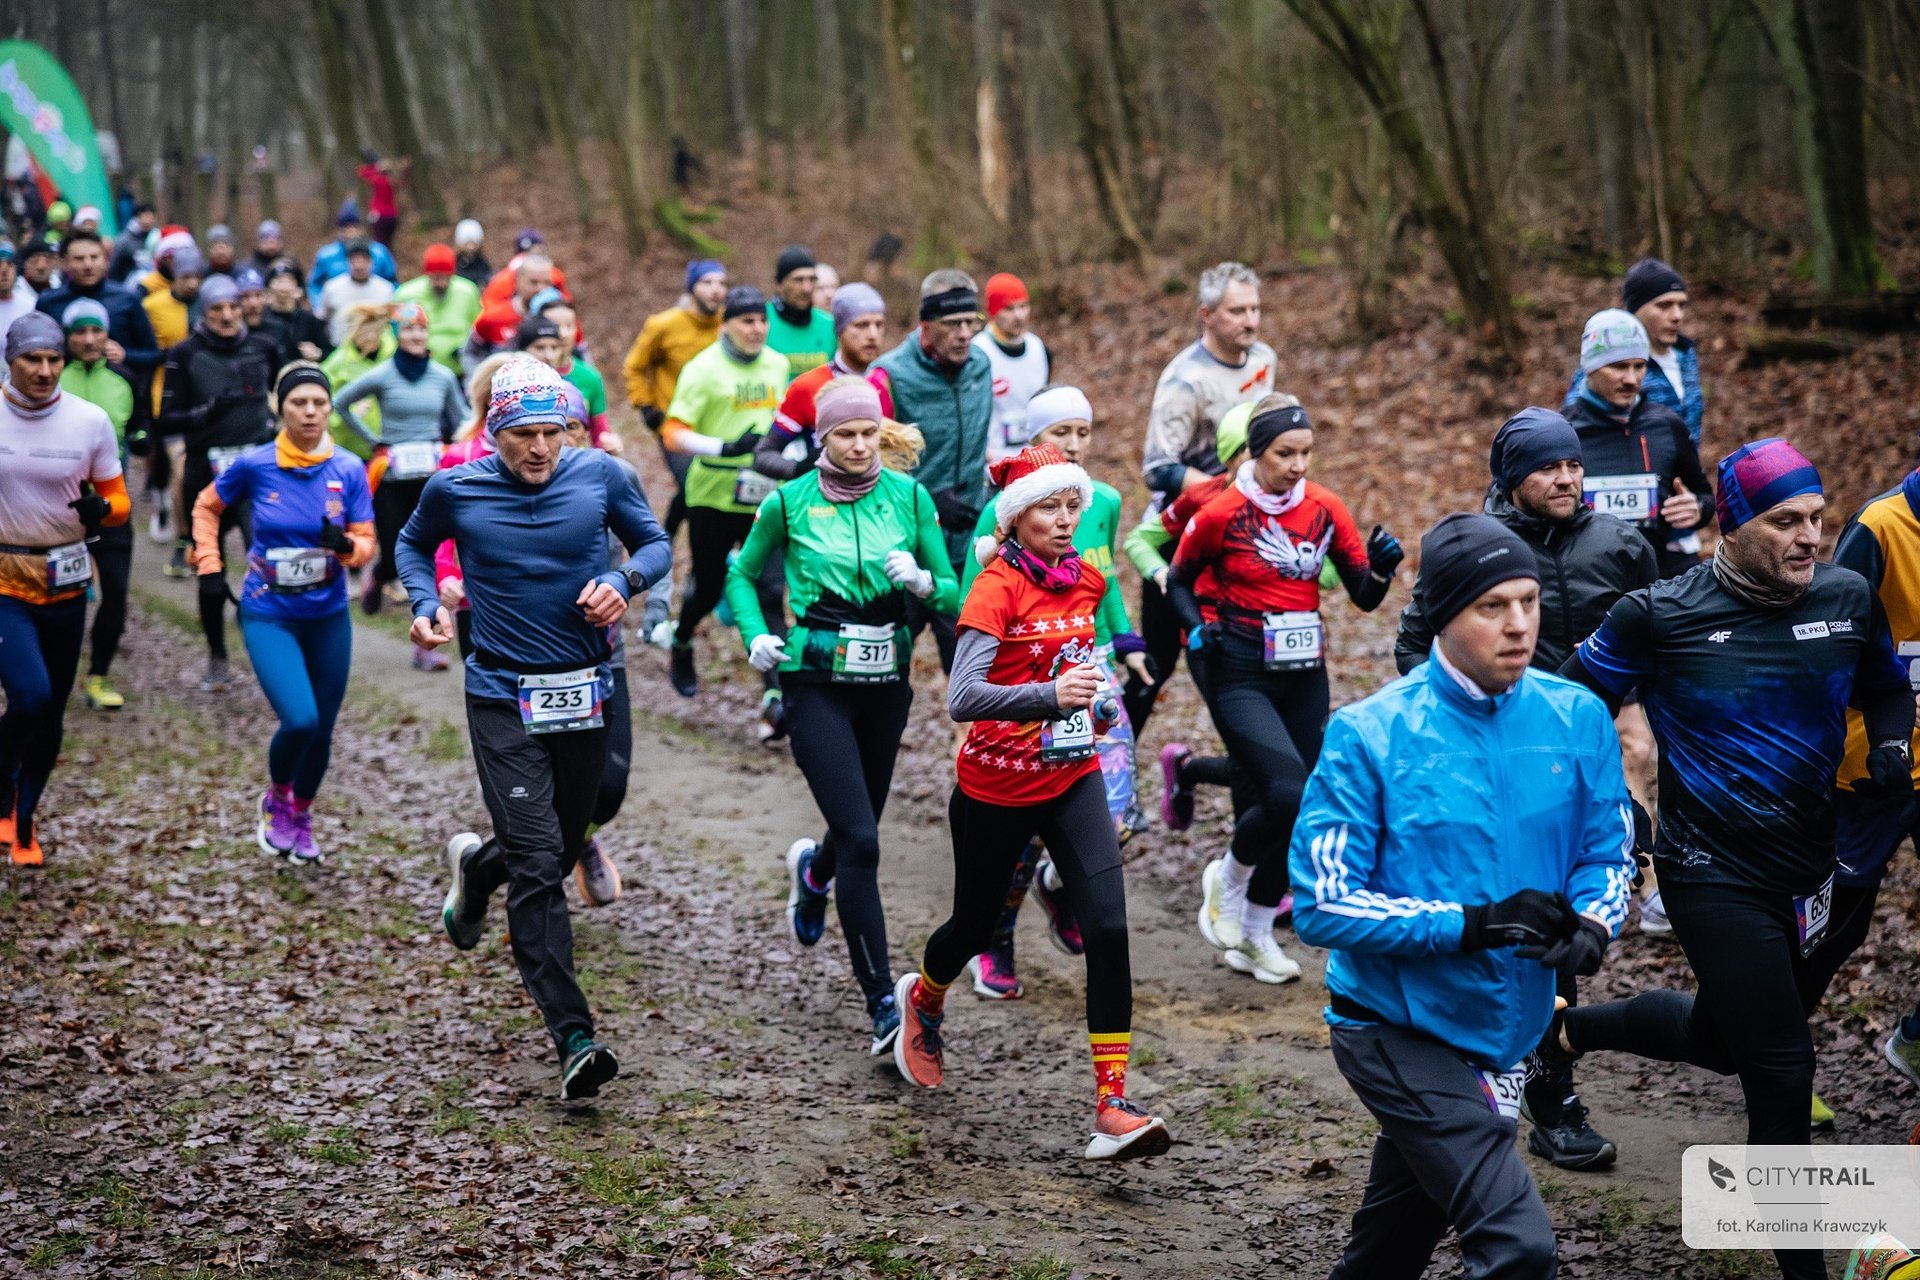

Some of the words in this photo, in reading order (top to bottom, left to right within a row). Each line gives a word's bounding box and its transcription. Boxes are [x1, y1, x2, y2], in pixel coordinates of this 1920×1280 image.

[1604, 493, 1638, 508] 148
[290, 561, 314, 576] 76
[1286, 631, 1313, 649] 619
[1707, 631, 1733, 643] 4F
[858, 644, 888, 662] 317
[540, 689, 583, 709] 233
